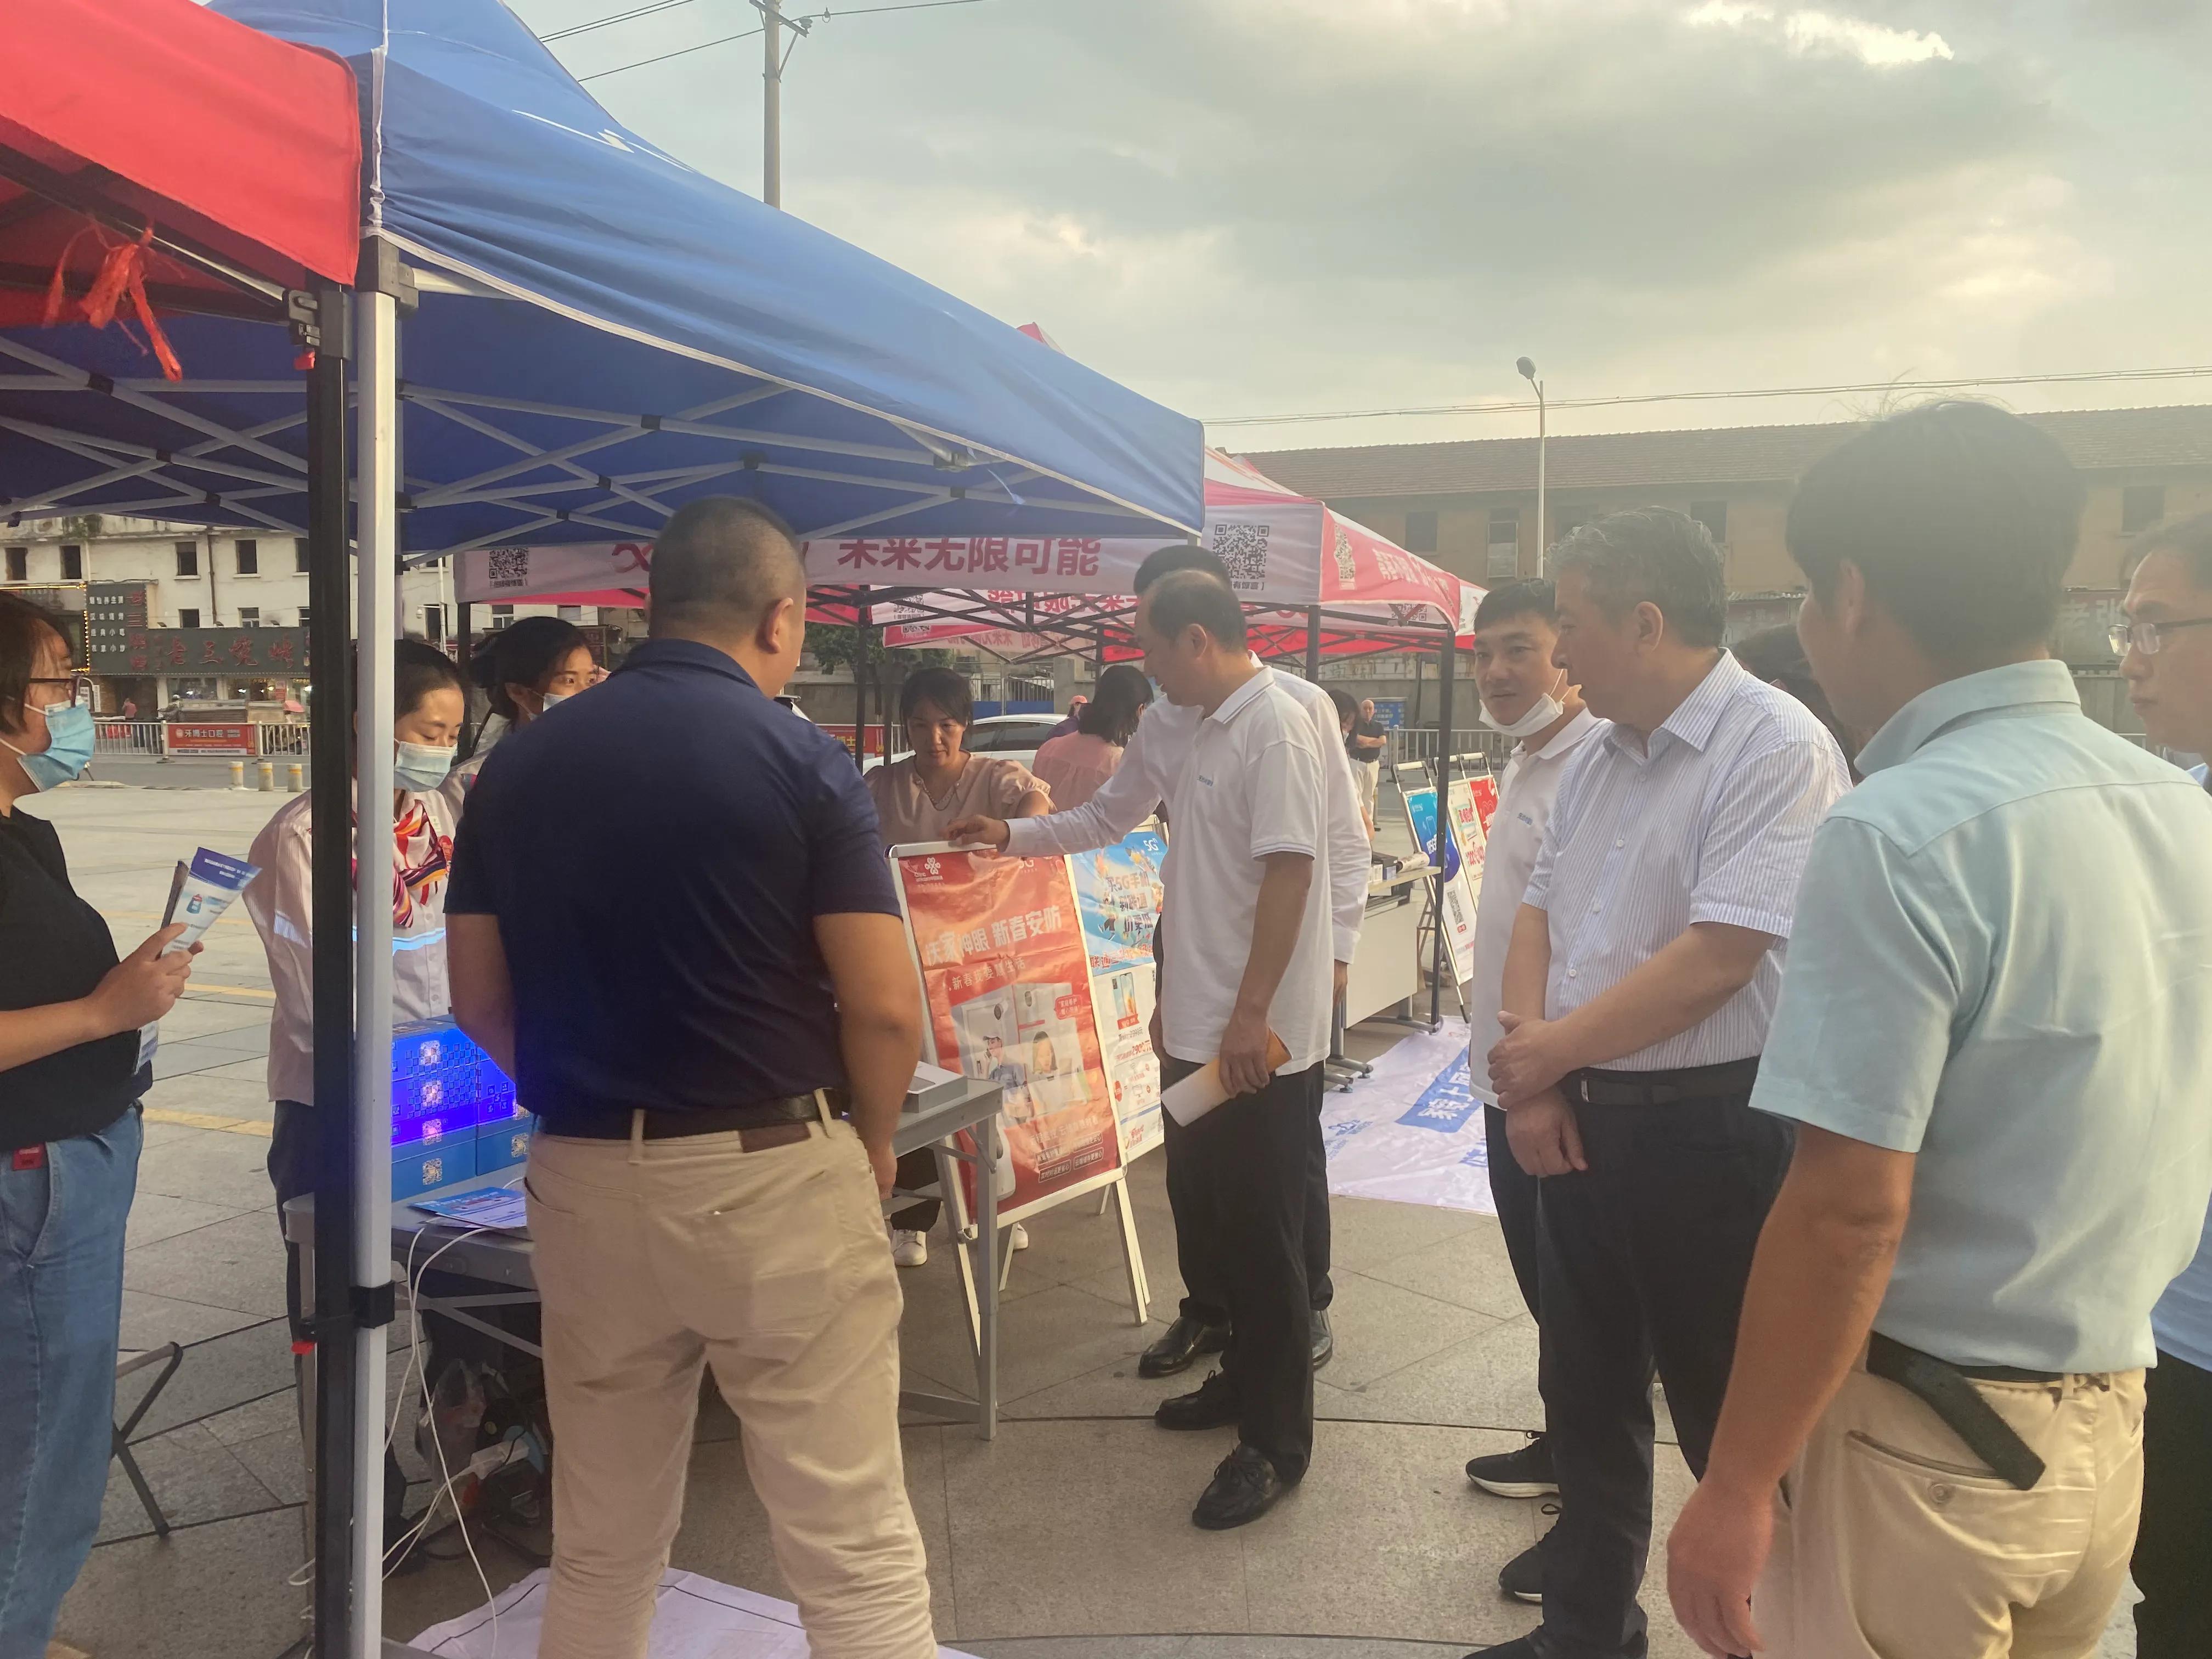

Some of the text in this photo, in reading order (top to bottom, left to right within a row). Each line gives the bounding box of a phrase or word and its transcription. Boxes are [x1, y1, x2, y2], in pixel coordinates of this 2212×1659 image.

[837, 537, 1102, 576] 未来无限可能
[184, 729, 224, 738] 牙博士口腔
[991, 905, 1062, 948] 新春安防
